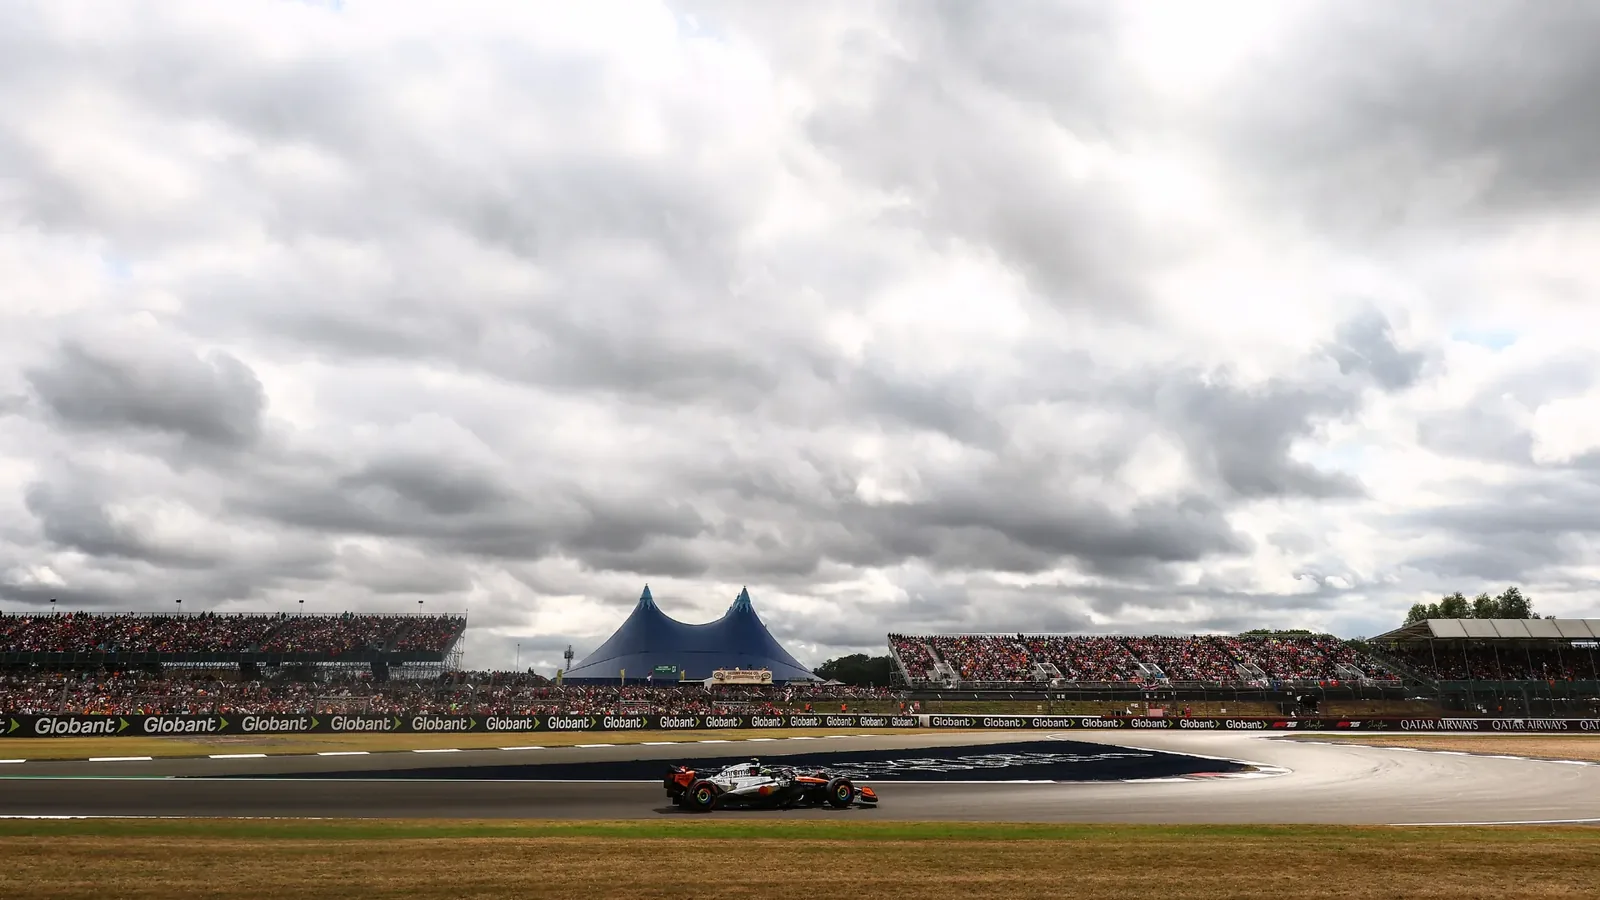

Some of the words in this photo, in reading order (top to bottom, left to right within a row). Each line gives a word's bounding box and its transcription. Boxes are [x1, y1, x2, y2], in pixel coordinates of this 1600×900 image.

[35, 717, 115, 733] Globant
[144, 717, 215, 732] Globant
[242, 717, 307, 732] Globant
[331, 716, 391, 731] Globant
[412, 717, 467, 730] Globant
[486, 716, 532, 730] Globant
[548, 717, 589, 729] Globant
[604, 716, 641, 729] Globant
[660, 716, 694, 728] Globant
[706, 716, 737, 728] Globant
[752, 716, 780, 727] Globant
[791, 716, 818, 727] Globant
[827, 716, 852, 727] Globant
[860, 717, 884, 727] Globant
[892, 717, 914, 727] Globant
[933, 717, 970, 727] Globant
[984, 717, 1020, 727] Globant
[1033, 718, 1069, 728] Globant
[1082, 718, 1118, 728] Globant
[1131, 719, 1167, 728] Globant
[1180, 719, 1215, 729] Globant
[1226, 720, 1262, 729] Globant
[1401, 720, 1434, 730] QATAR
[1437, 720, 1478, 730] AIRWAYS
[1492, 720, 1525, 730] QATAR
[1527, 720, 1567, 730] AIRWAYS
